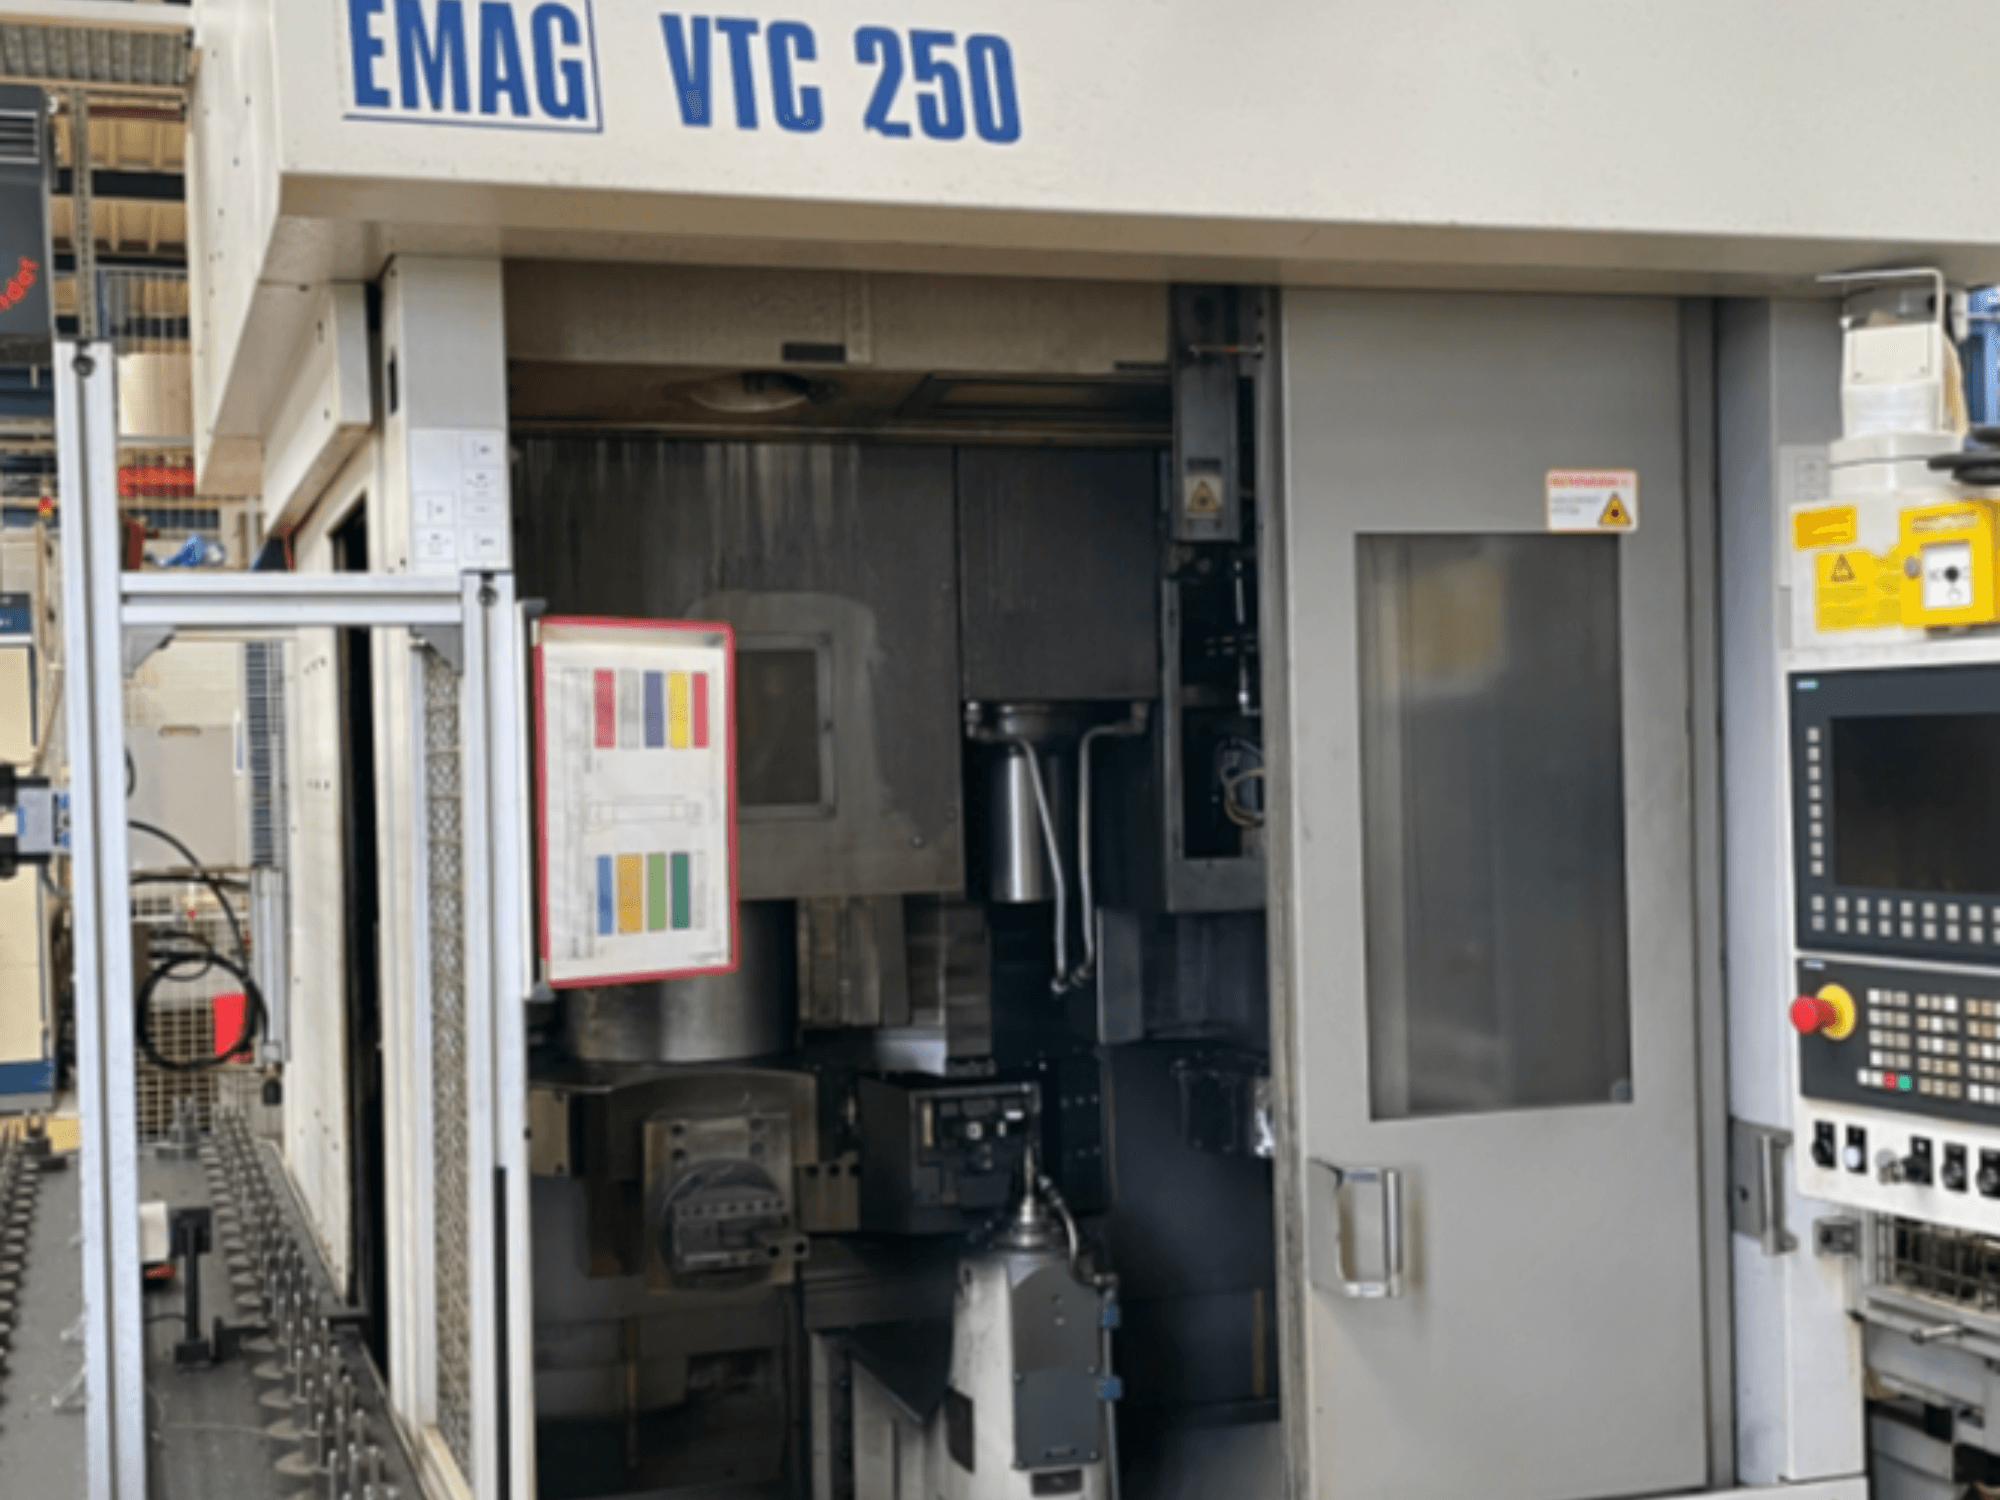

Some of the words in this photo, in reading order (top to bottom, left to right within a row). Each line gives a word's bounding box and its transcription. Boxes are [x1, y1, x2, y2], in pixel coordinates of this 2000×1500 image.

[347, 0, 588, 120] EMAG
[660, 13, 824, 134] VTC
[854, 27, 1022, 144] 250
